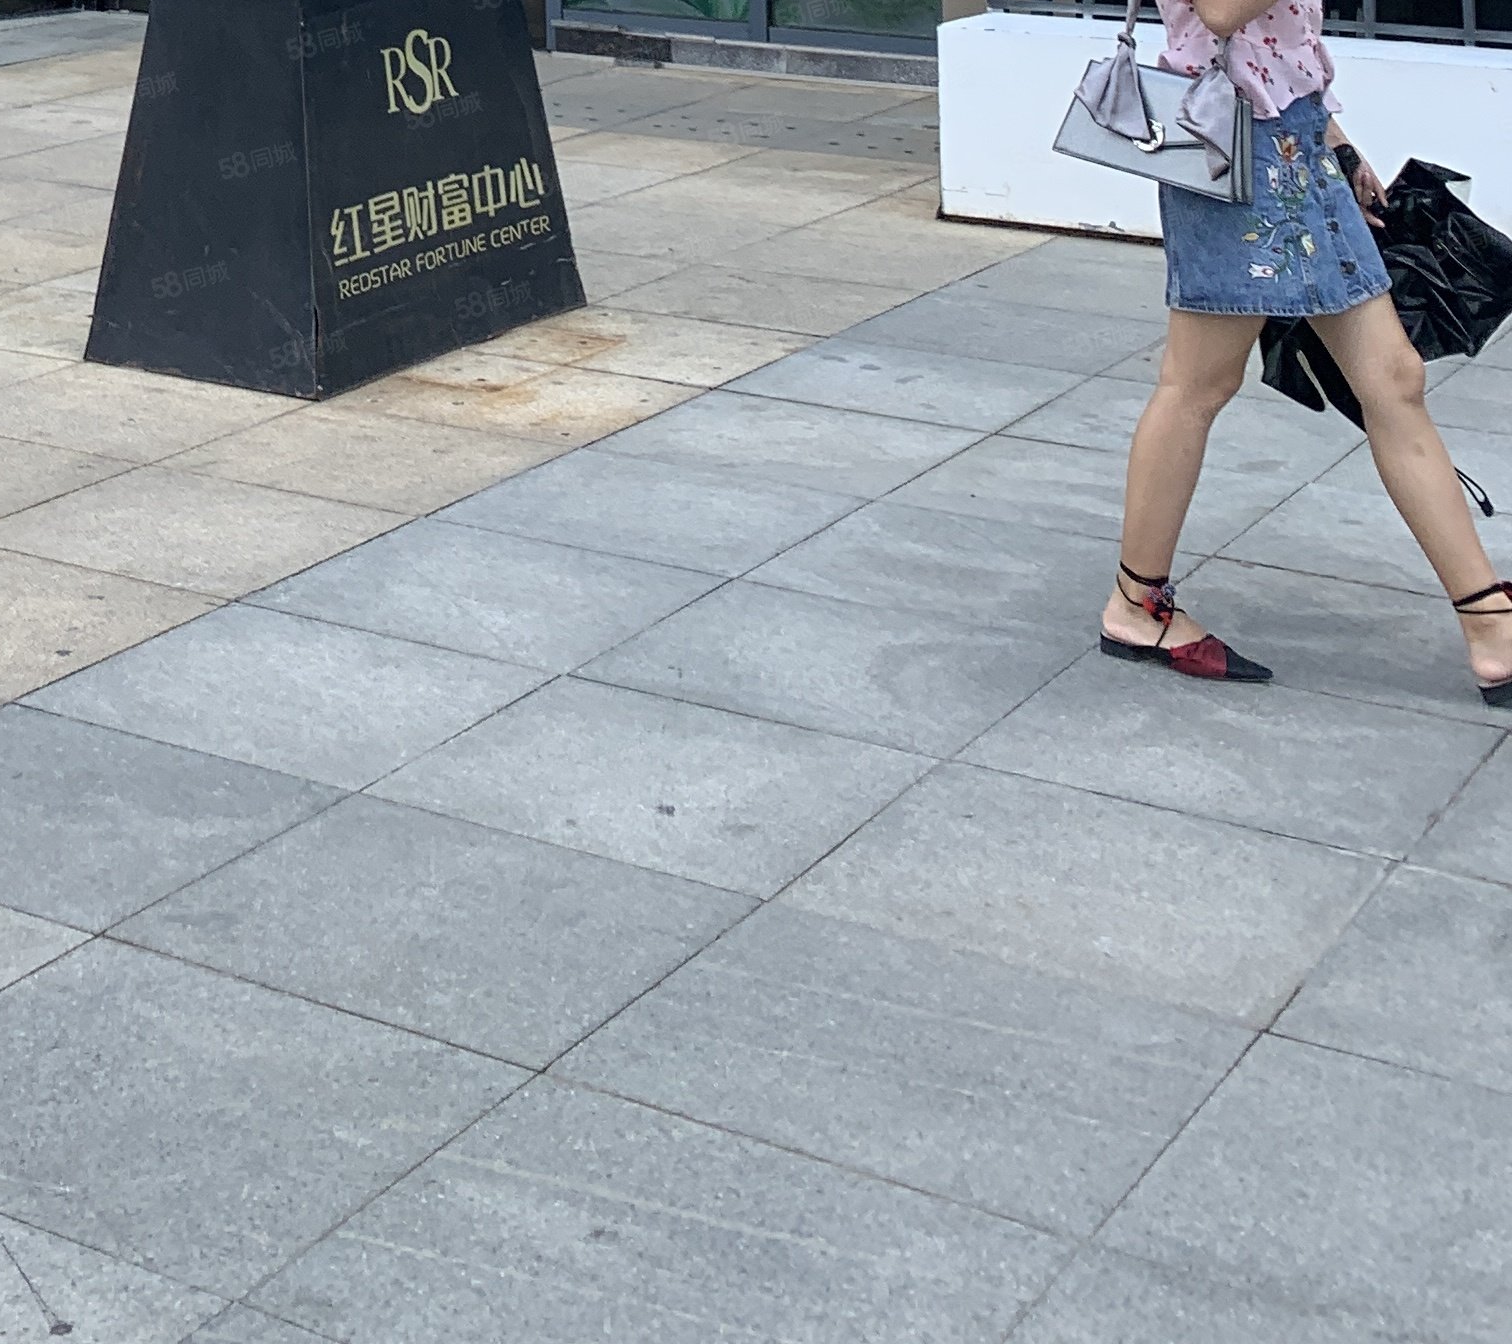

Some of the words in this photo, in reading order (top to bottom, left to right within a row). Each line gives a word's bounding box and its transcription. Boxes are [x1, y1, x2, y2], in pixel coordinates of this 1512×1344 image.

[379, 28, 460, 115] RSR
[330, 157, 545, 266] 红星财富中心
[339, 261, 412, 300] REDSTAR
[416, 233, 487, 273] FORTUNE
[490, 215, 552, 250] CENTER
